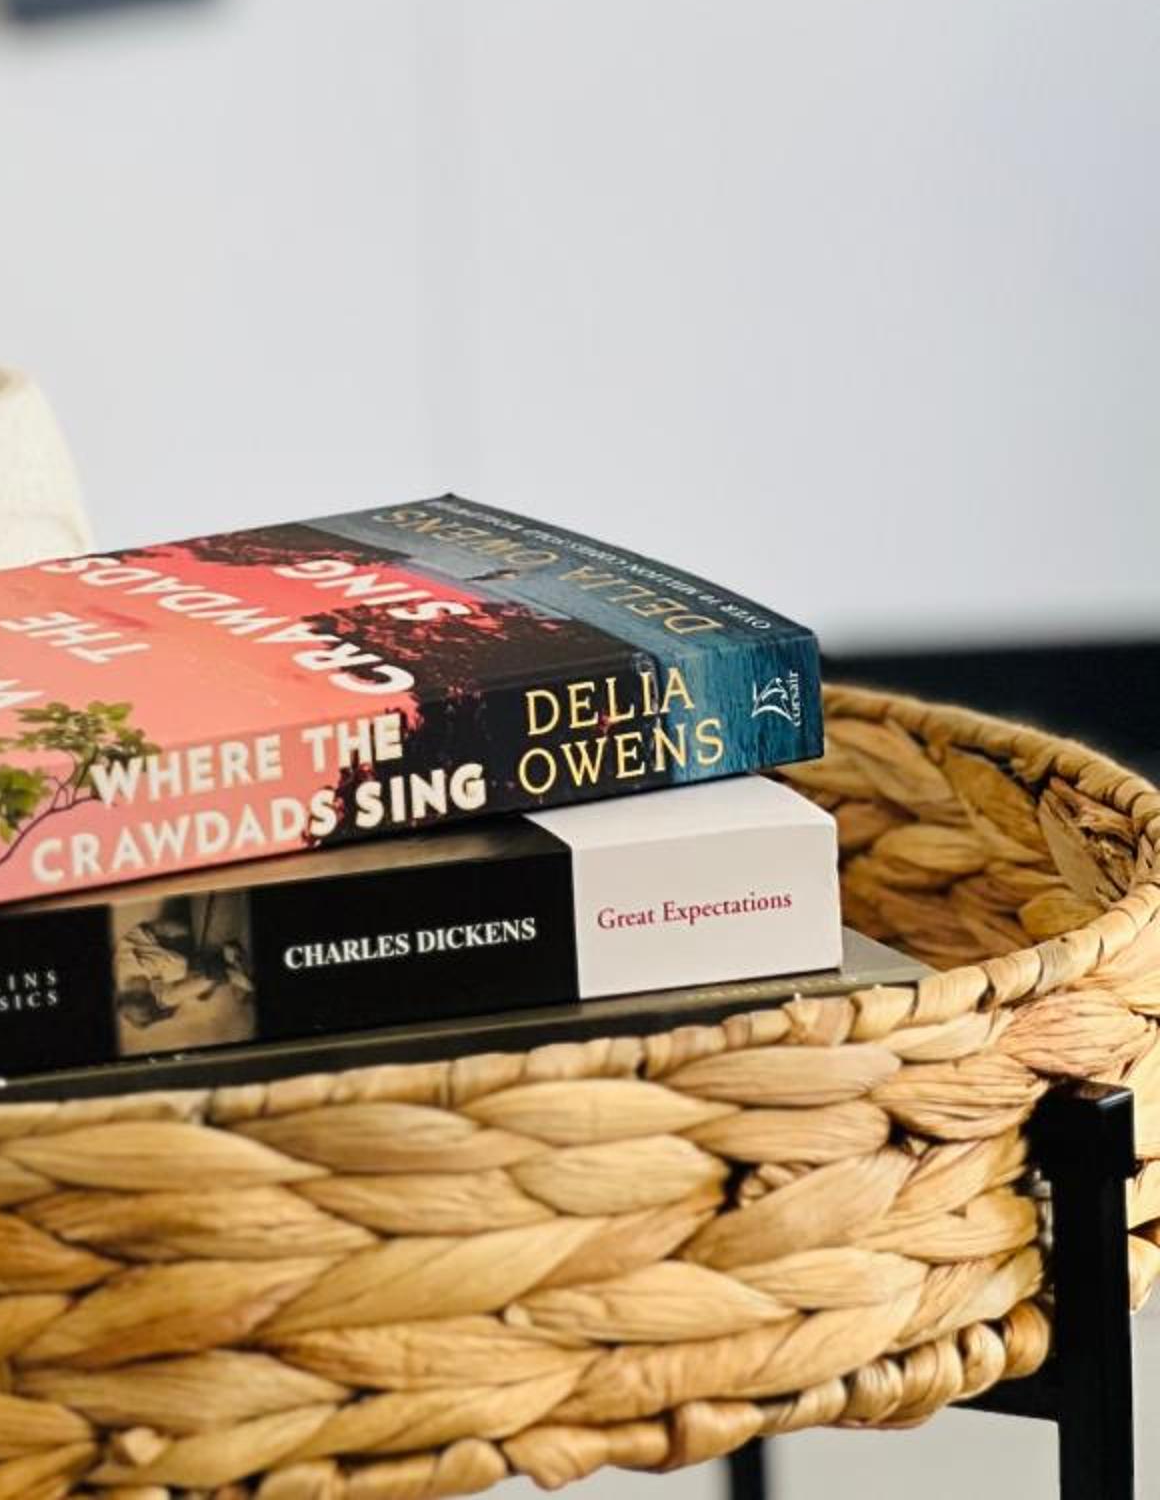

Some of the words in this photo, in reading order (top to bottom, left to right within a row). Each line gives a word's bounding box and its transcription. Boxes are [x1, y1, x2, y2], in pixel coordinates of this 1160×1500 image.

[373, 508, 560, 567] OWENS
[39, 557, 416, 695] CRAWDADS
[272, 559, 471, 622] SING
[559, 565, 723, 636] DELIA
[525, 666, 695, 737] DELIA
[90, 733, 284, 807] WHERE
[301, 712, 404, 772] THE
[517, 717, 726, 796] OWENS
[31, 788, 338, 885] CRAWDADS
[354, 762, 488, 830] SING
[283, 932, 410, 971] CHARLES
[416, 917, 537, 955] DICKENS
[596, 906, 655, 931] Great
[662, 890, 793, 926] Expectations
